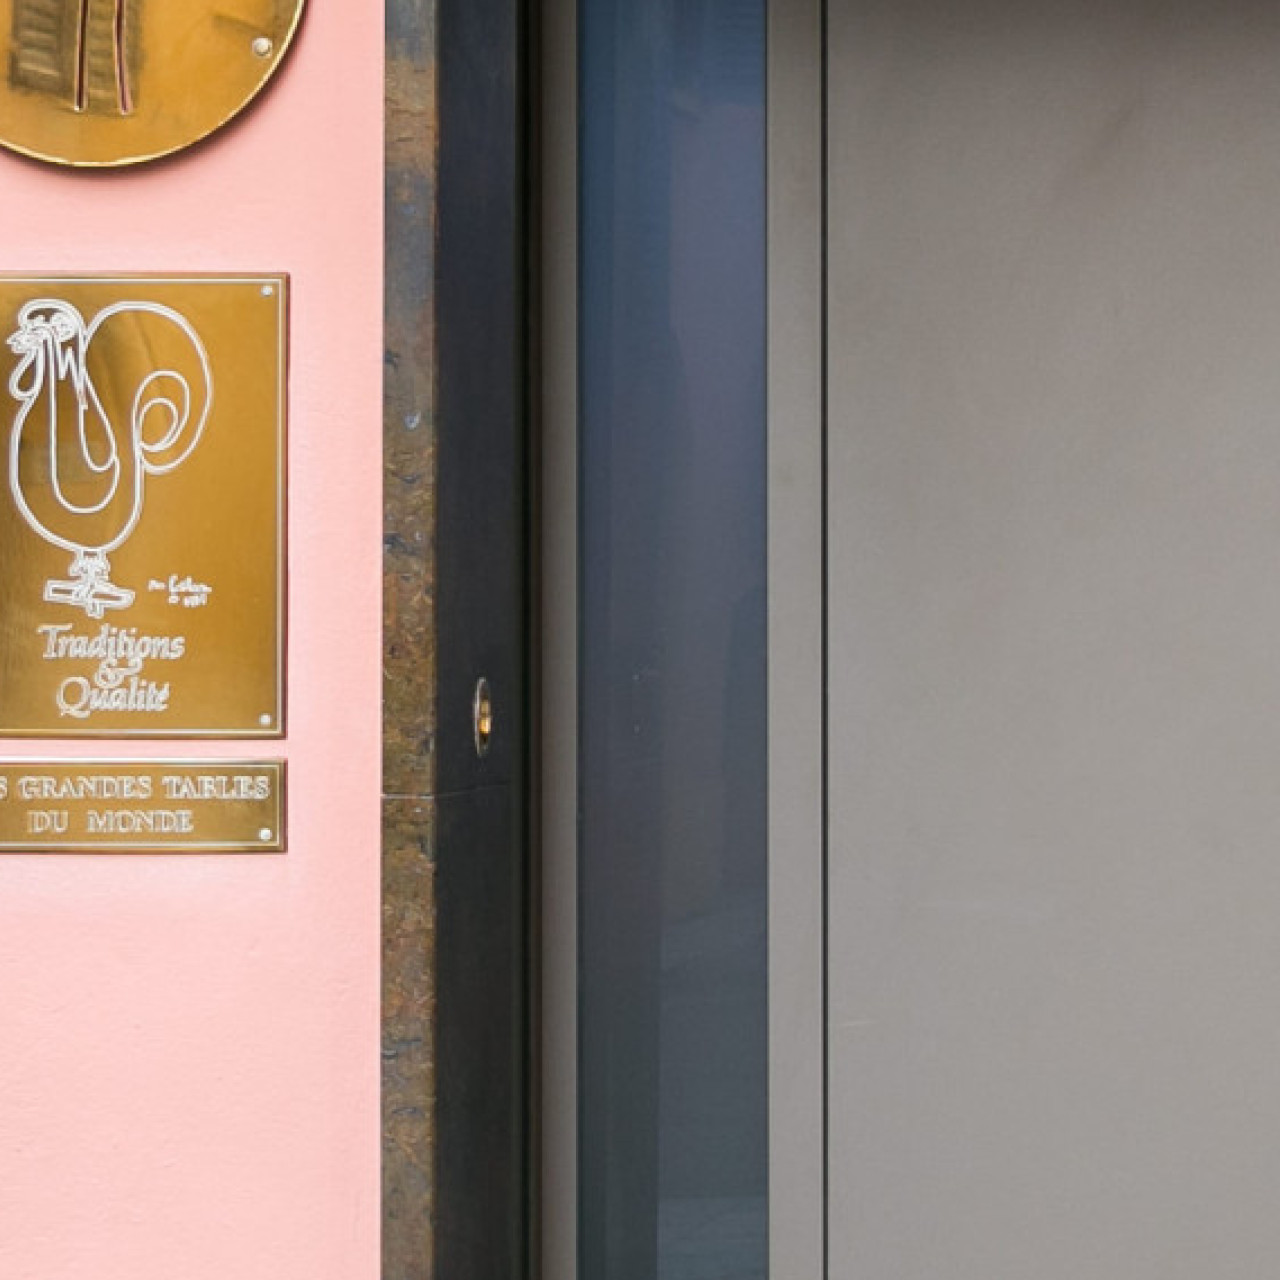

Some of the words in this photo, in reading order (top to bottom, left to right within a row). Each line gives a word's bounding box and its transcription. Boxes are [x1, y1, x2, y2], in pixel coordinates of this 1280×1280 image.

[36, 623, 186, 660] Traditions
[18, 775, 152, 800] GRANDES
[161, 775, 272, 800] TABLES
[28, 810, 69, 833] DU
[86, 810, 195, 833] MONDE
